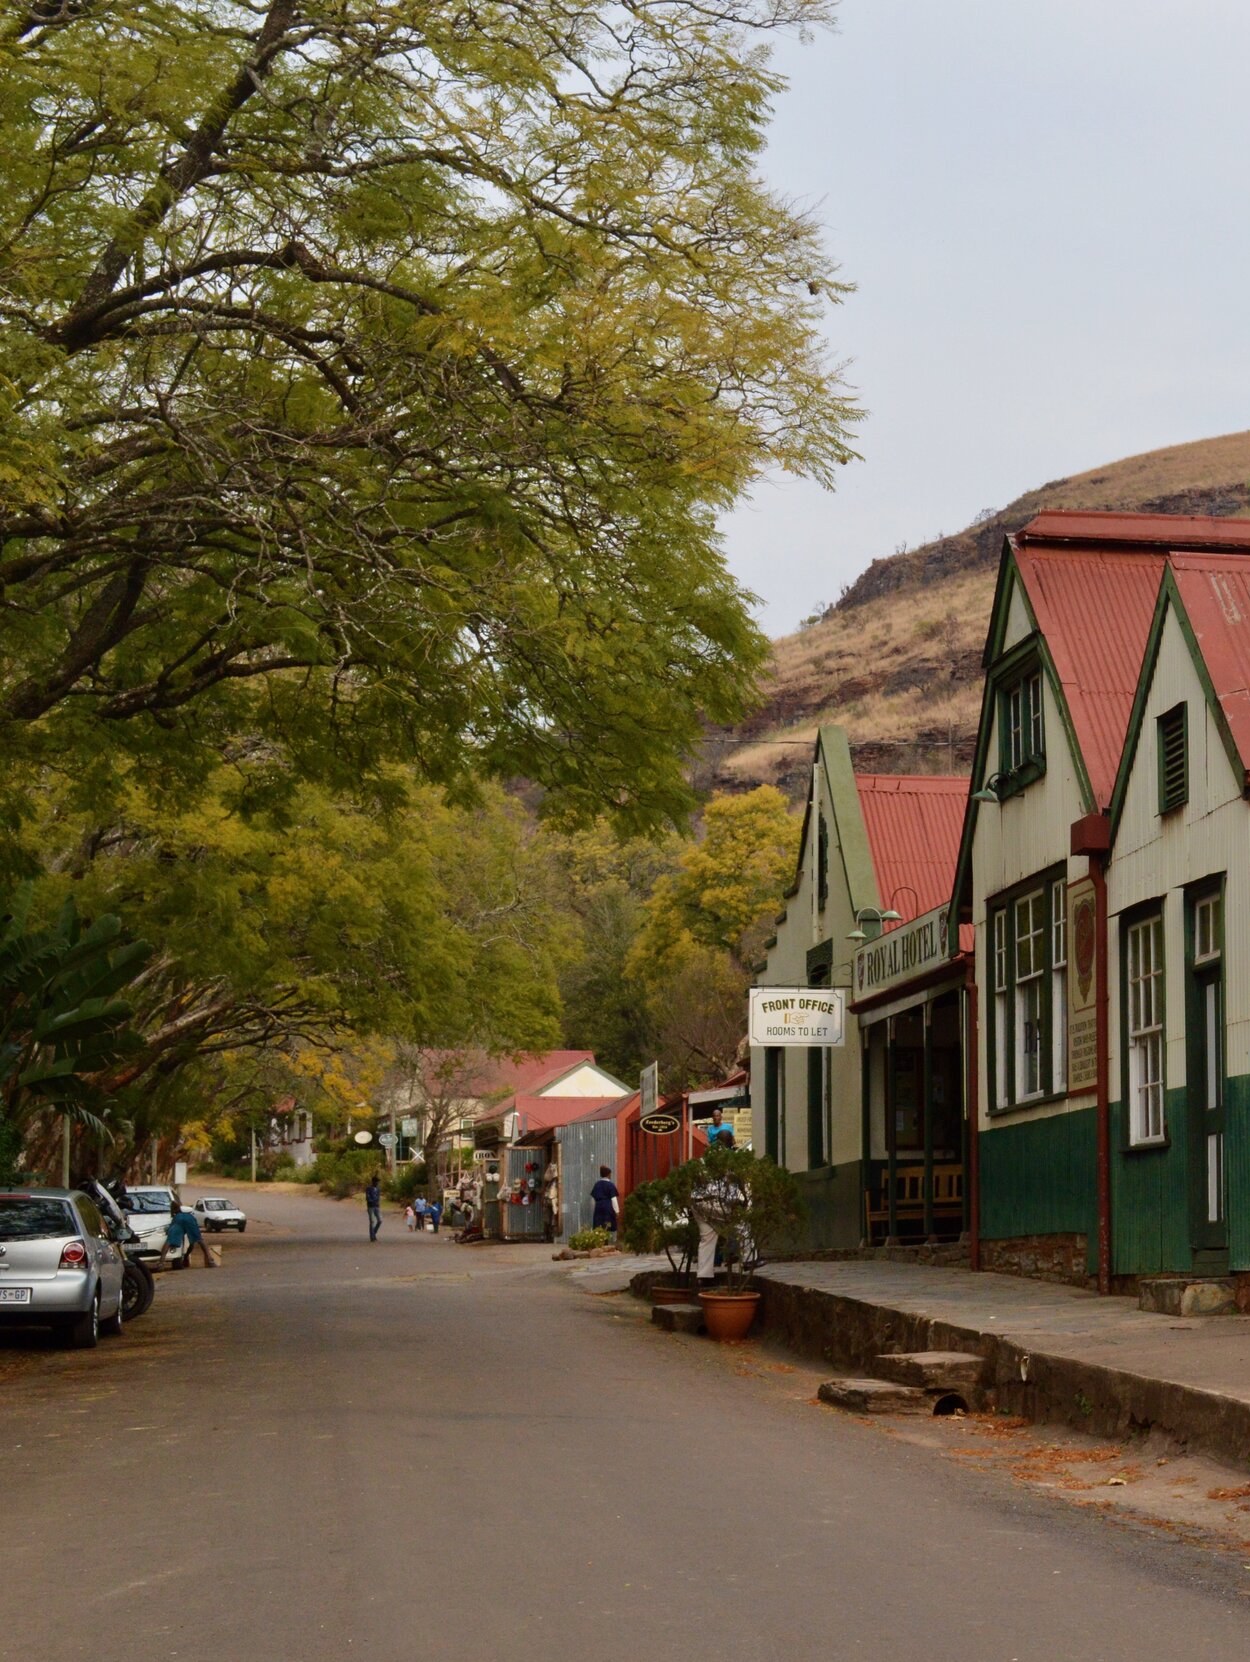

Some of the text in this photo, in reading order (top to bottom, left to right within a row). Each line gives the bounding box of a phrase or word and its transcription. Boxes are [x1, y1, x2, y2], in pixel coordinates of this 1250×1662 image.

[866, 921, 937, 986] ROYAL HOTEL
[761, 998, 834, 1015] FRONT OFFICE
[766, 1026, 828, 1037] ROOMS TO LET
